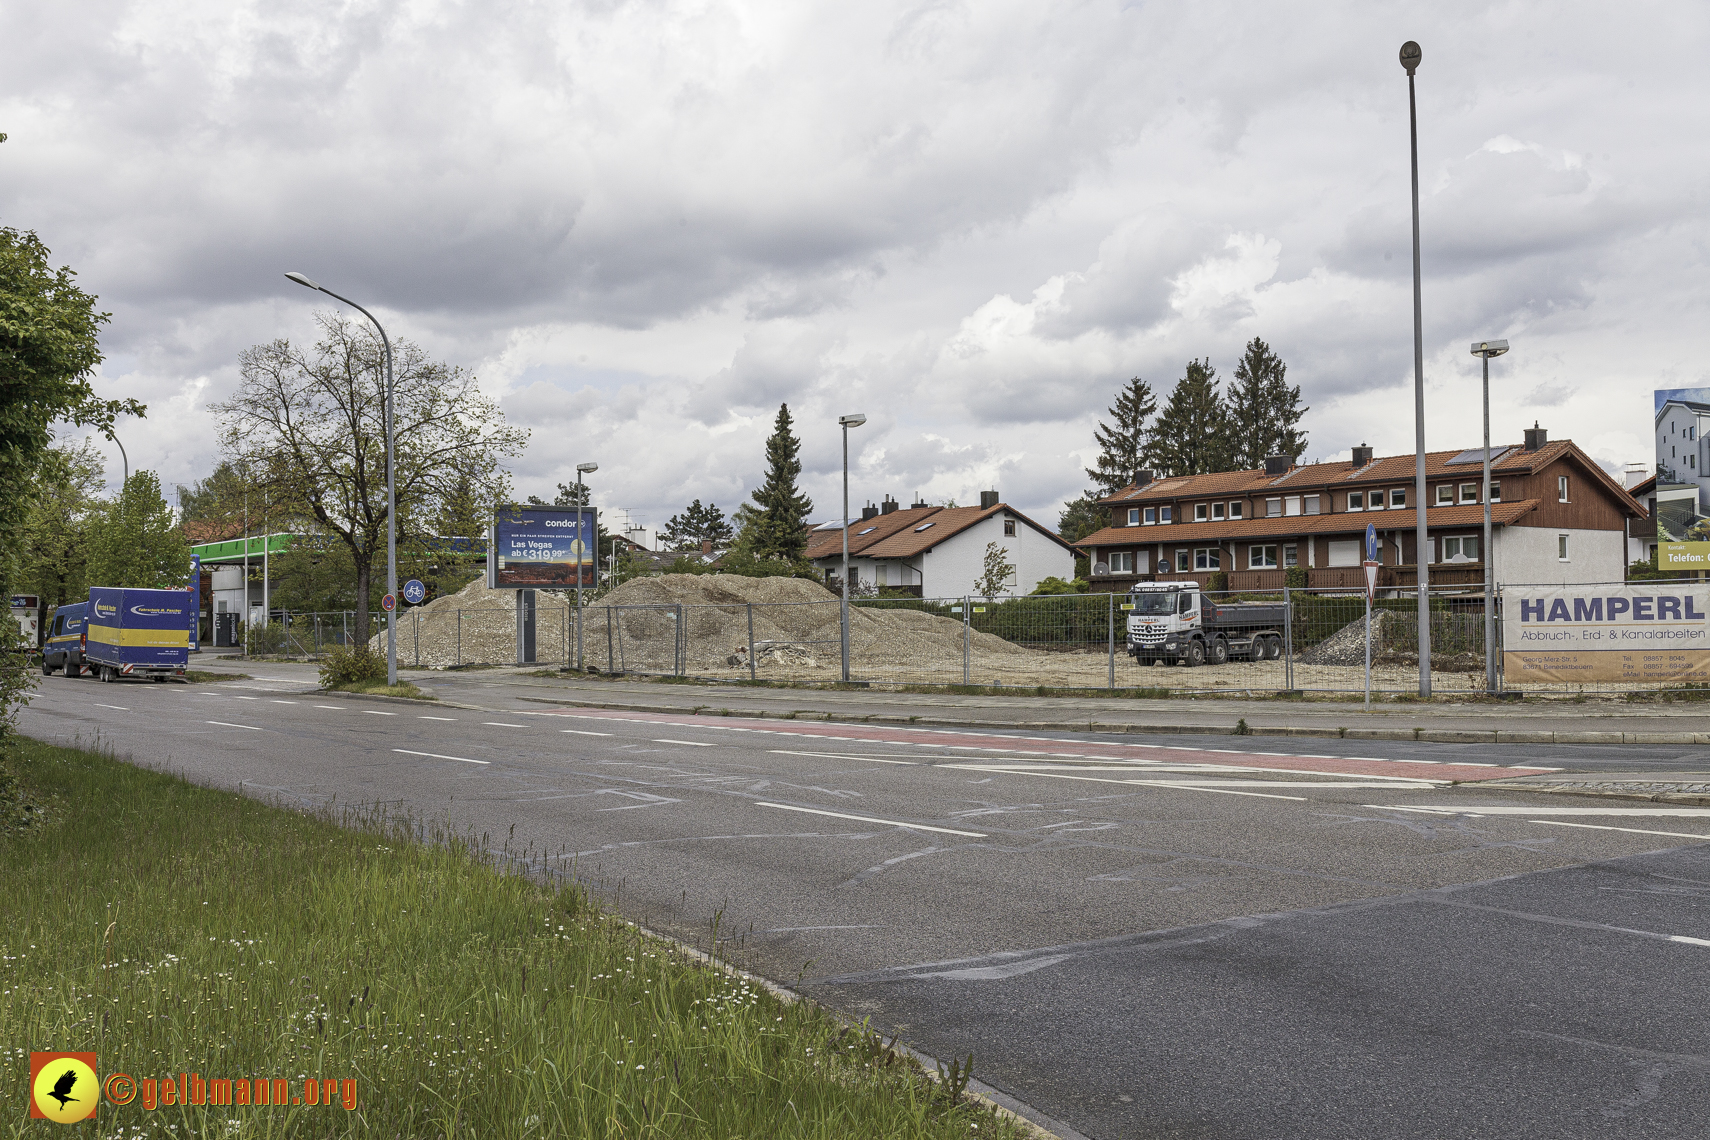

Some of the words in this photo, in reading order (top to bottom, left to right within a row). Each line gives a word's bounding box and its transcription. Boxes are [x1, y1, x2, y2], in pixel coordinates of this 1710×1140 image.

[546, 519, 576, 528] condor
[528, 540, 553, 549] Vegas
[1668, 553, 1704, 562] Telefon:
[1521, 596, 1705, 622] HAMPERL
[1521, 630, 1579, 641] Abbruch-,
[1582, 630, 1605, 640] Erd-
[1609, 630, 1618, 640] &
[1622, 628, 1706, 640] Kanalarbeiten
